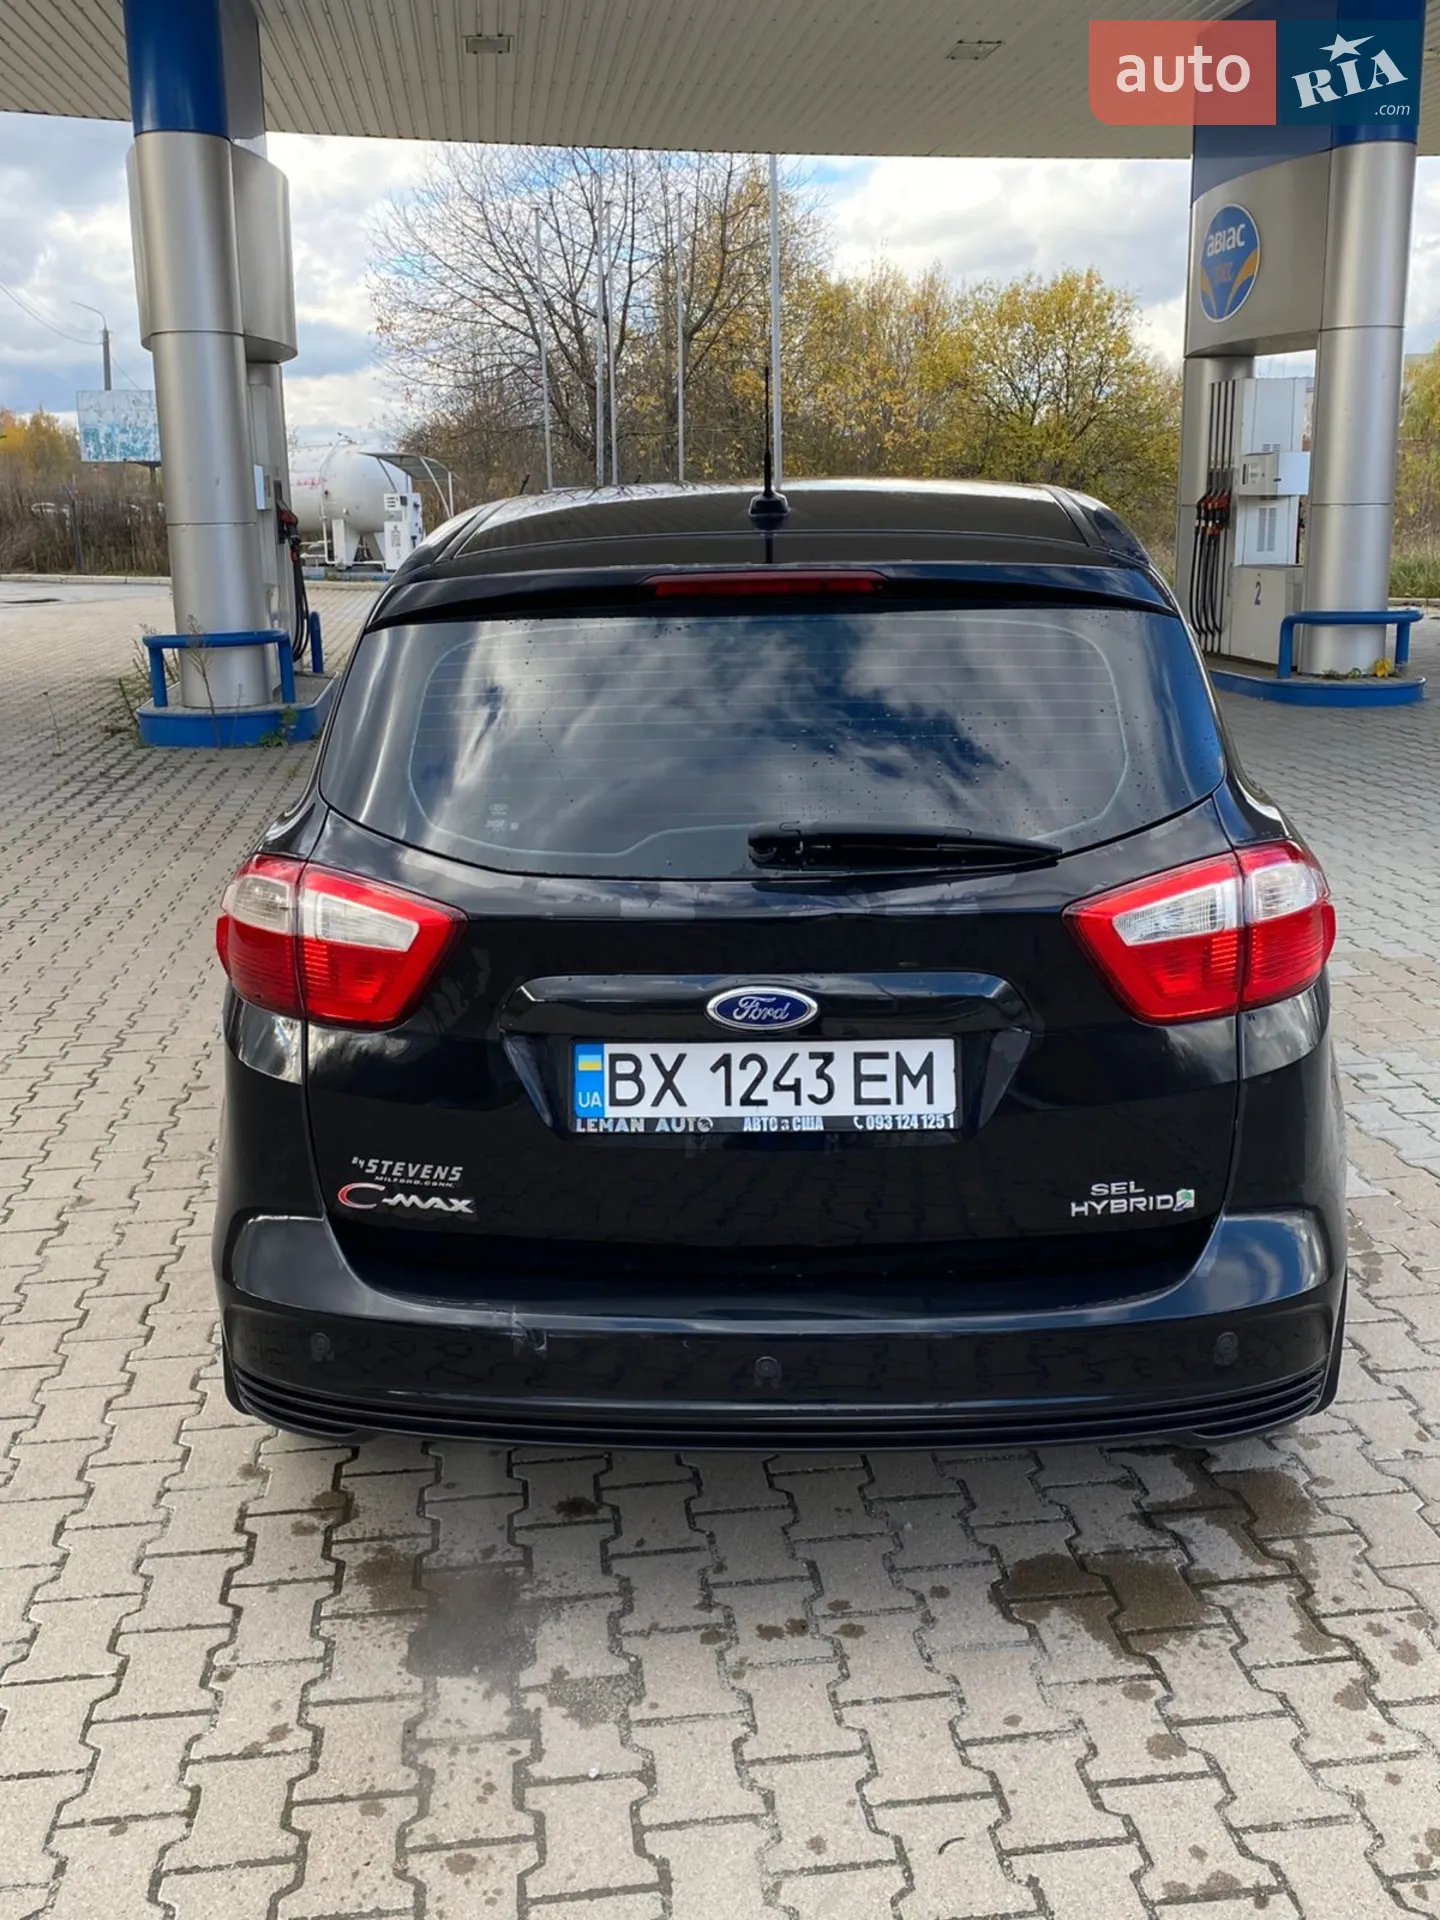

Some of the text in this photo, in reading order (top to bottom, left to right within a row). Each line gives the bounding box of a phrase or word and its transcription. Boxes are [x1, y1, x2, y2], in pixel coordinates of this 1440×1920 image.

[1254, 581, 1261, 605] 2
[732, 995, 789, 1021] Ford
[608, 1051, 934, 1107] BX 1243 EM
[578, 1091, 602, 1108] UA
[576, 1117, 645, 1132] LEMAN
[743, 1116, 777, 1131] АВТО
[792, 1116, 824, 1131] США
[866, 1115, 893, 1130] 093
[365, 1159, 463, 1181] STEVENS
[1090, 1180, 1145, 1196] SEL
[1070, 1194, 1174, 1217] HYBRID
